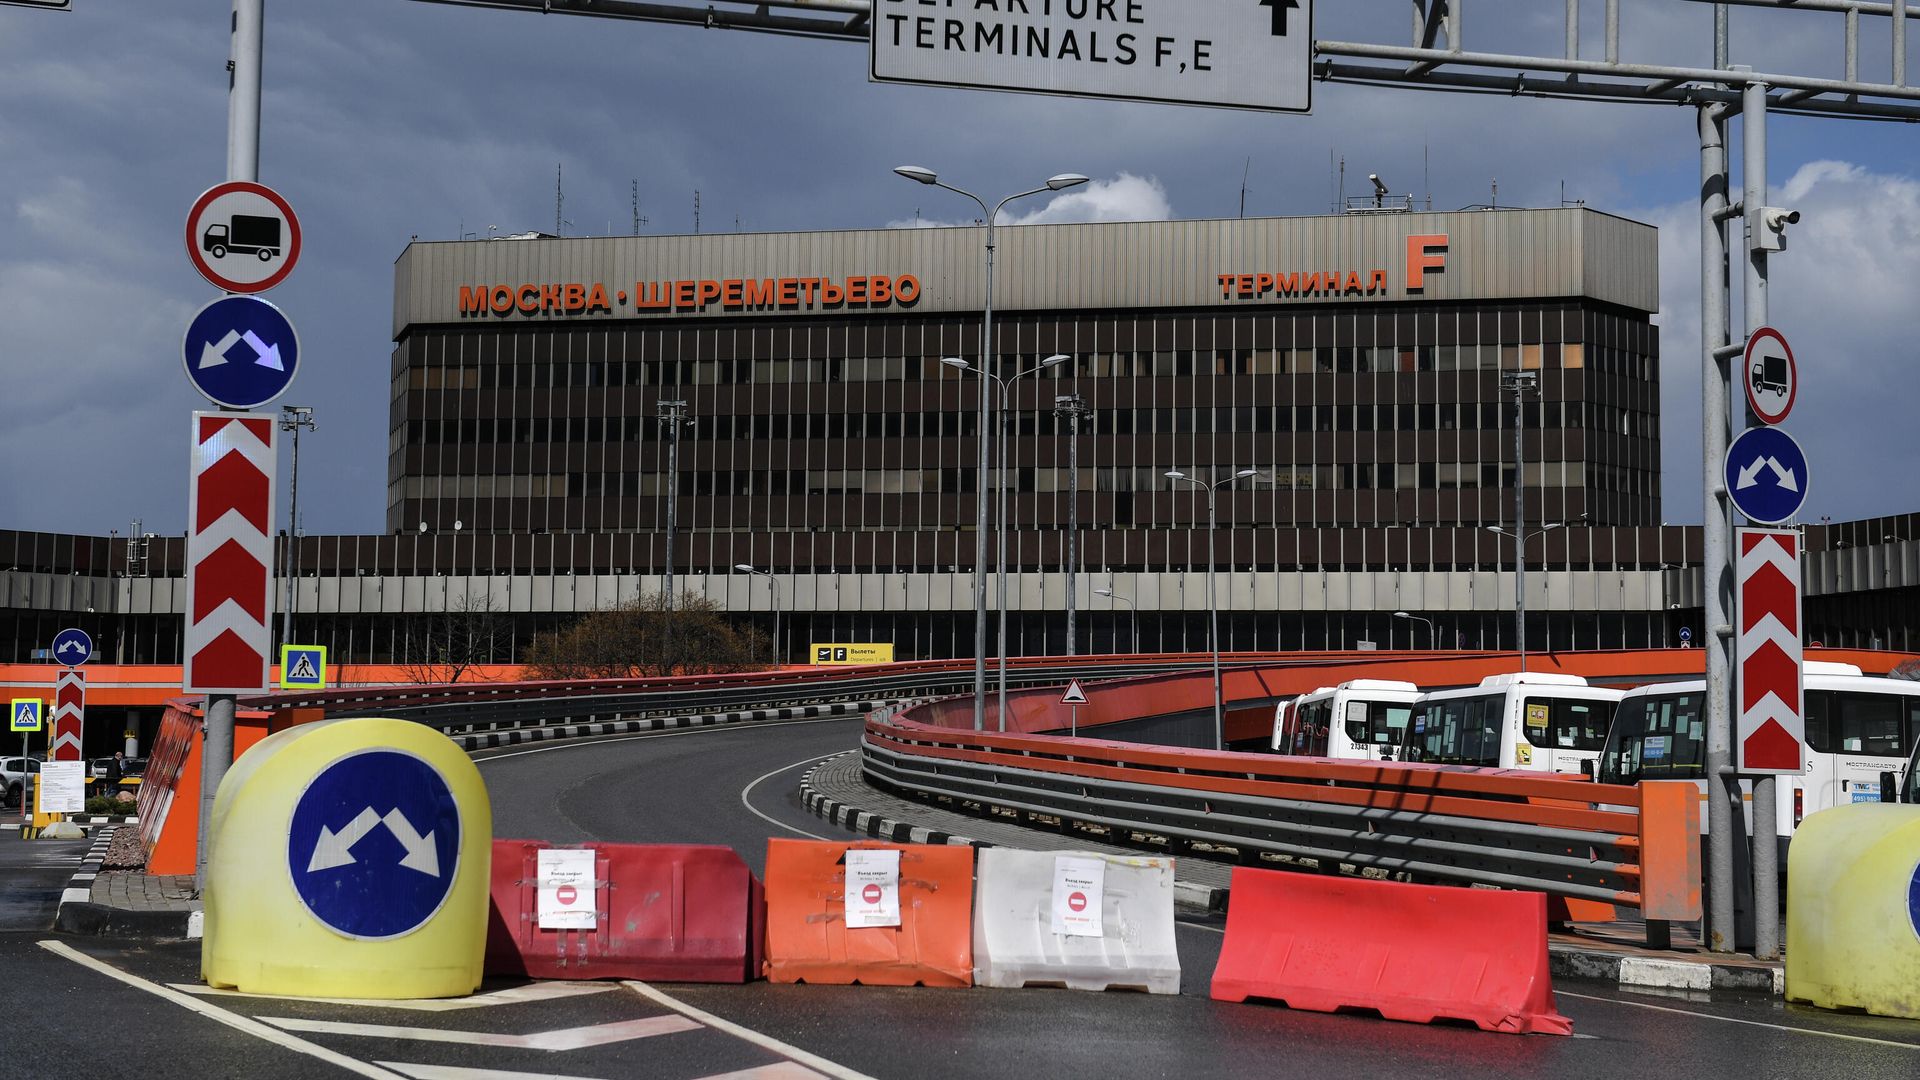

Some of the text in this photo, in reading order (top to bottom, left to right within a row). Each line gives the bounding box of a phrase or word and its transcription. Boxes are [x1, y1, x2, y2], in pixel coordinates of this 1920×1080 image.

[886, 14, 1137, 65] TERMINALS
[1217, 234, 1448, 298] ТЕРМИНАЛ F
[458, 274, 921, 314] МОСКВА ШЕРЕМЕТЬЕВО
[1807, 761, 1813, 772] 5
